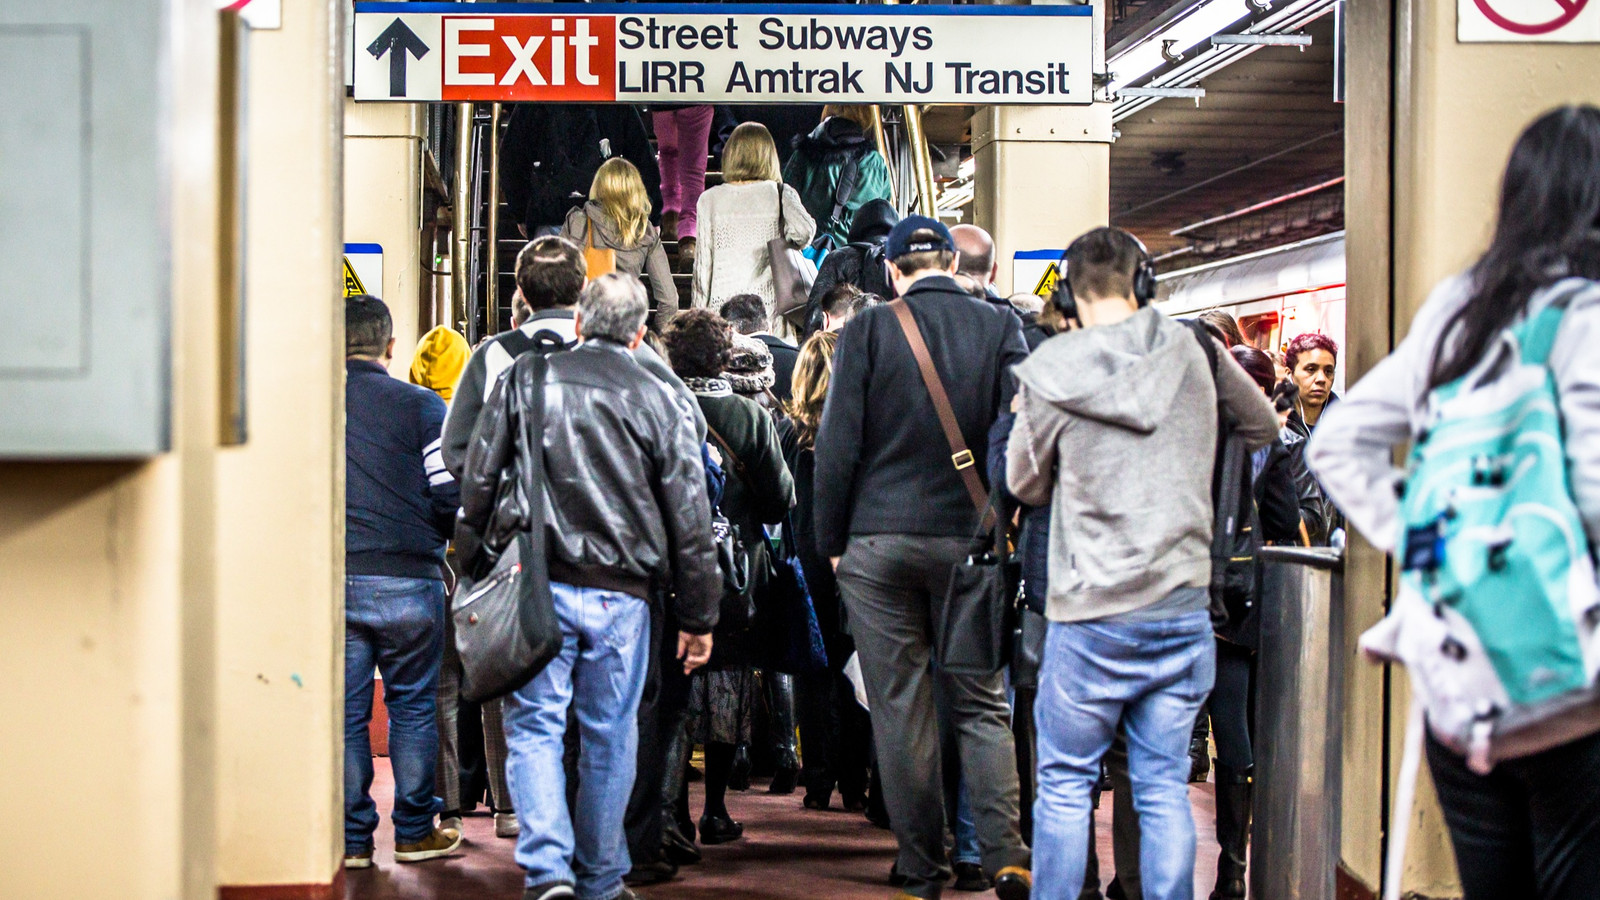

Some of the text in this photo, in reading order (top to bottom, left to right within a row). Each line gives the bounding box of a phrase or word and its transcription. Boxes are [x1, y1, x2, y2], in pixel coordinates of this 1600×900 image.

[444, 18, 600, 86] Exit
[619, 16, 933, 58] Street Subways
[619, 60, 1070, 95] LIRR Amtrak NJ Transit
